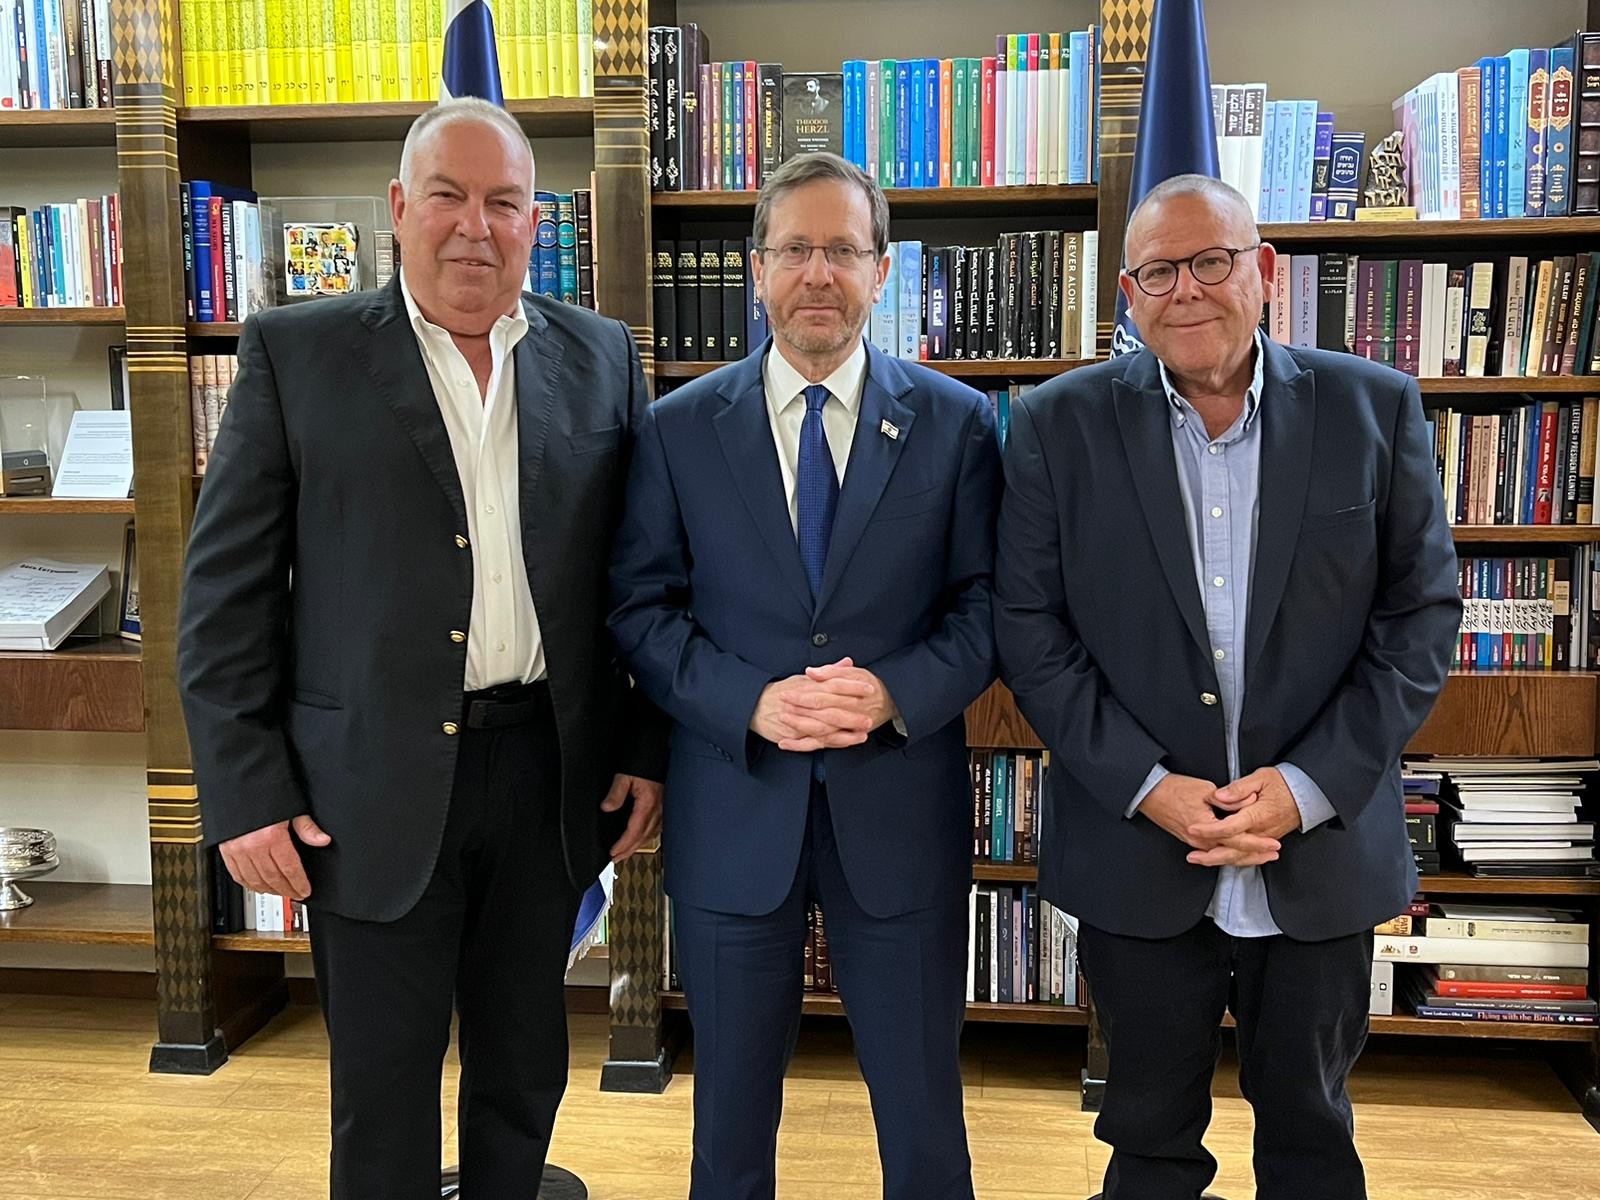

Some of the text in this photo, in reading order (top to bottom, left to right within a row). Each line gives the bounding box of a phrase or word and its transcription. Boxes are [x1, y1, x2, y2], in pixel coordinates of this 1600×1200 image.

[766, 97, 771, 107] AM
[1245, 92, 1255, 134] חיים הרצוג
[665, 107, 675, 140] ישראל
[1364, 187, 1406, 206] אגדה
[933, 289, 943, 326] בן גוריון
[1090, 295, 1095, 303] OF
[1509, 297, 1518, 312] דרך
[1573, 292, 1582, 315] מלחמת
[1569, 319, 1578, 345] יום-הדין
[1571, 409, 1580, 434] LETTERS
[1570, 442, 1578, 473] PRESIDENT
[1568, 475, 1576, 500] CLINTON
[1400, 918, 1408, 934] PATH
[1478, 1012, 1500, 1021] Flying
